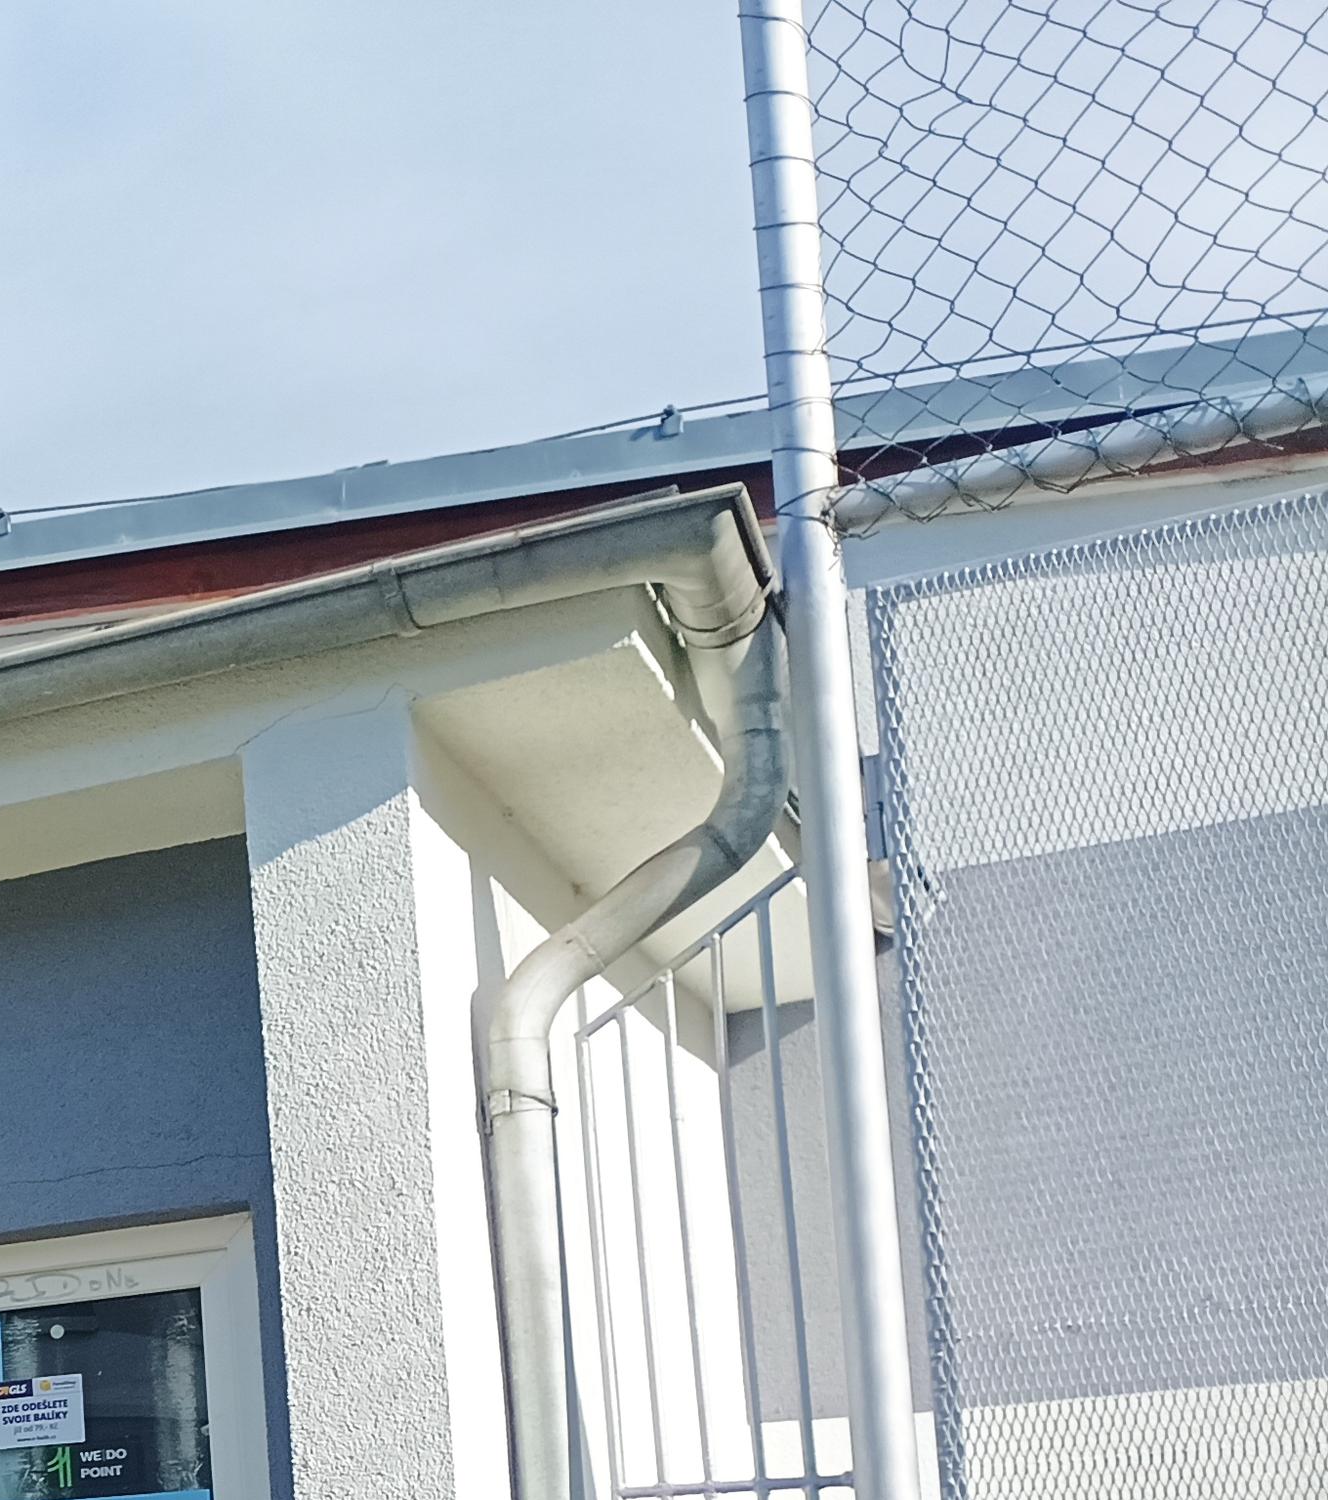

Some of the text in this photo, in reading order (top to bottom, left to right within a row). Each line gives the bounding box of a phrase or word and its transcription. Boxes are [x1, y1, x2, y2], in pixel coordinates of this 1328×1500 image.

[8, 1383, 28, 1396] GLS
[1, 1399, 68, 1414] ZDE ODEŠLETE
[2, 1410, 68, 1426] SVOJE BALÍKY
[80, 1465, 123, 1479] POINT
